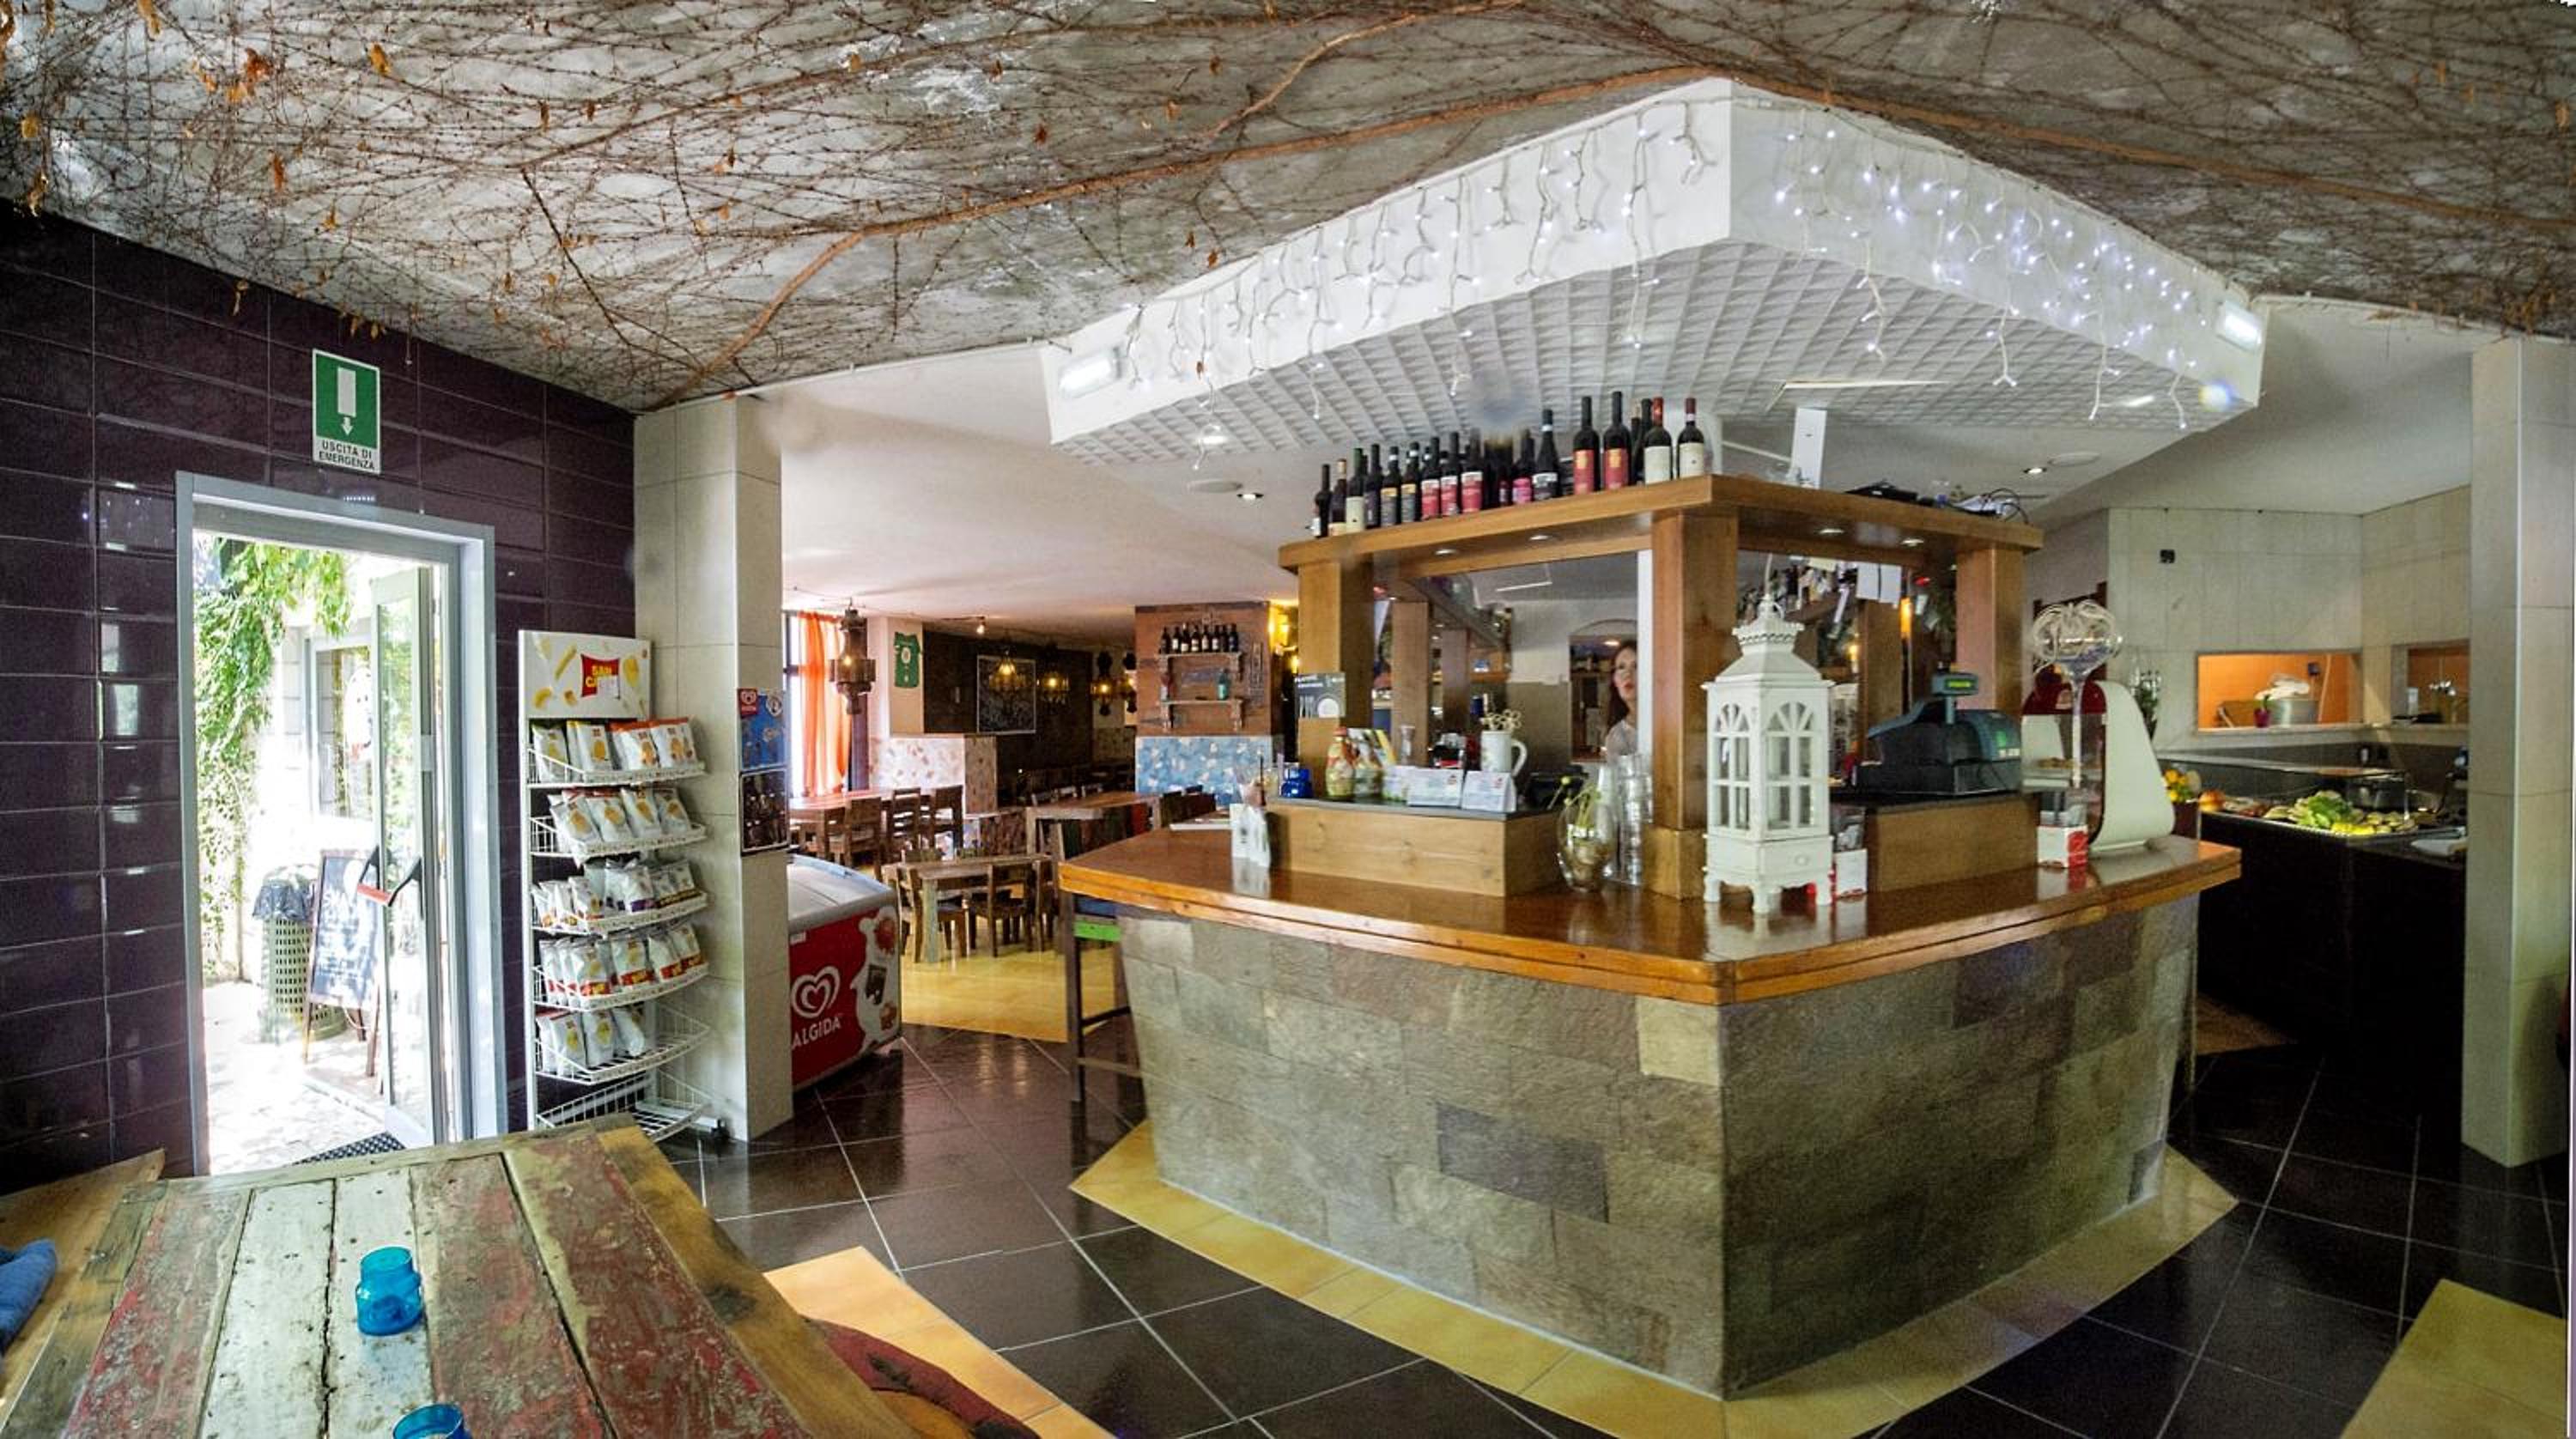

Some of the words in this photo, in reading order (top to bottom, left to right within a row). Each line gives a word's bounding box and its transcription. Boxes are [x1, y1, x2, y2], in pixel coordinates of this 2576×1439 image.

[322, 440, 358, 456] USCITA
[361, 448, 372, 459] DI
[319, 451, 375, 470] EMERGENZA
[792, 1016, 841, 1050] ALGIDA
